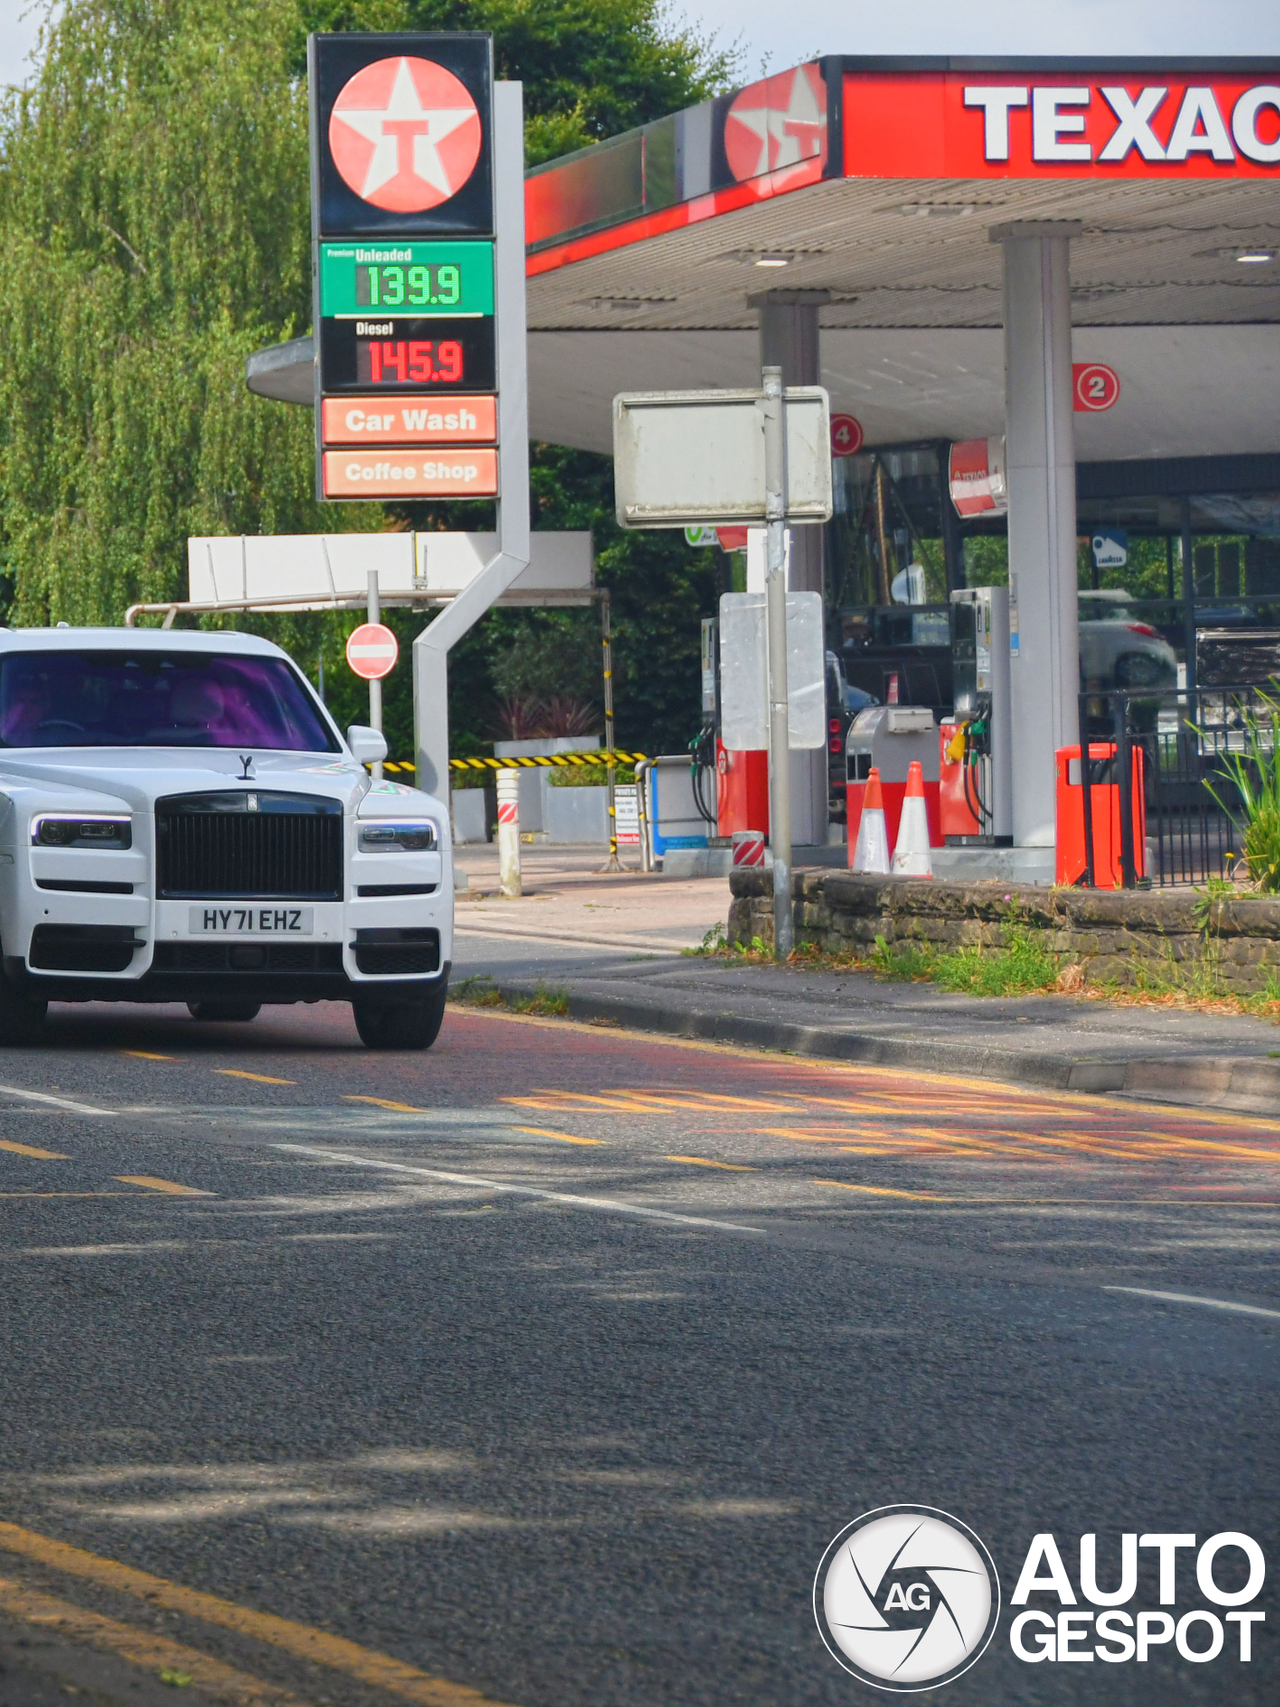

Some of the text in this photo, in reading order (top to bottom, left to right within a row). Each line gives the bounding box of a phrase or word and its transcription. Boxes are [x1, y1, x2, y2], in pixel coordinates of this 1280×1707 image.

[326, 248, 413, 262] Premium Unleaded
[368, 265, 460, 305] 139.9
[356, 321, 394, 336] Diesel
[368, 340, 463, 382] 145.9
[1088, 376, 1106, 398] 2
[345, 409, 476, 431] Car Wash
[835, 425, 851, 444] 4
[345, 462, 478, 482] Coffee Shop
[203, 909, 302, 930] HY71 EHZ
[498, 1088, 1094, 1116] STOP
[757, 1127, 1280, 1162] BUS
